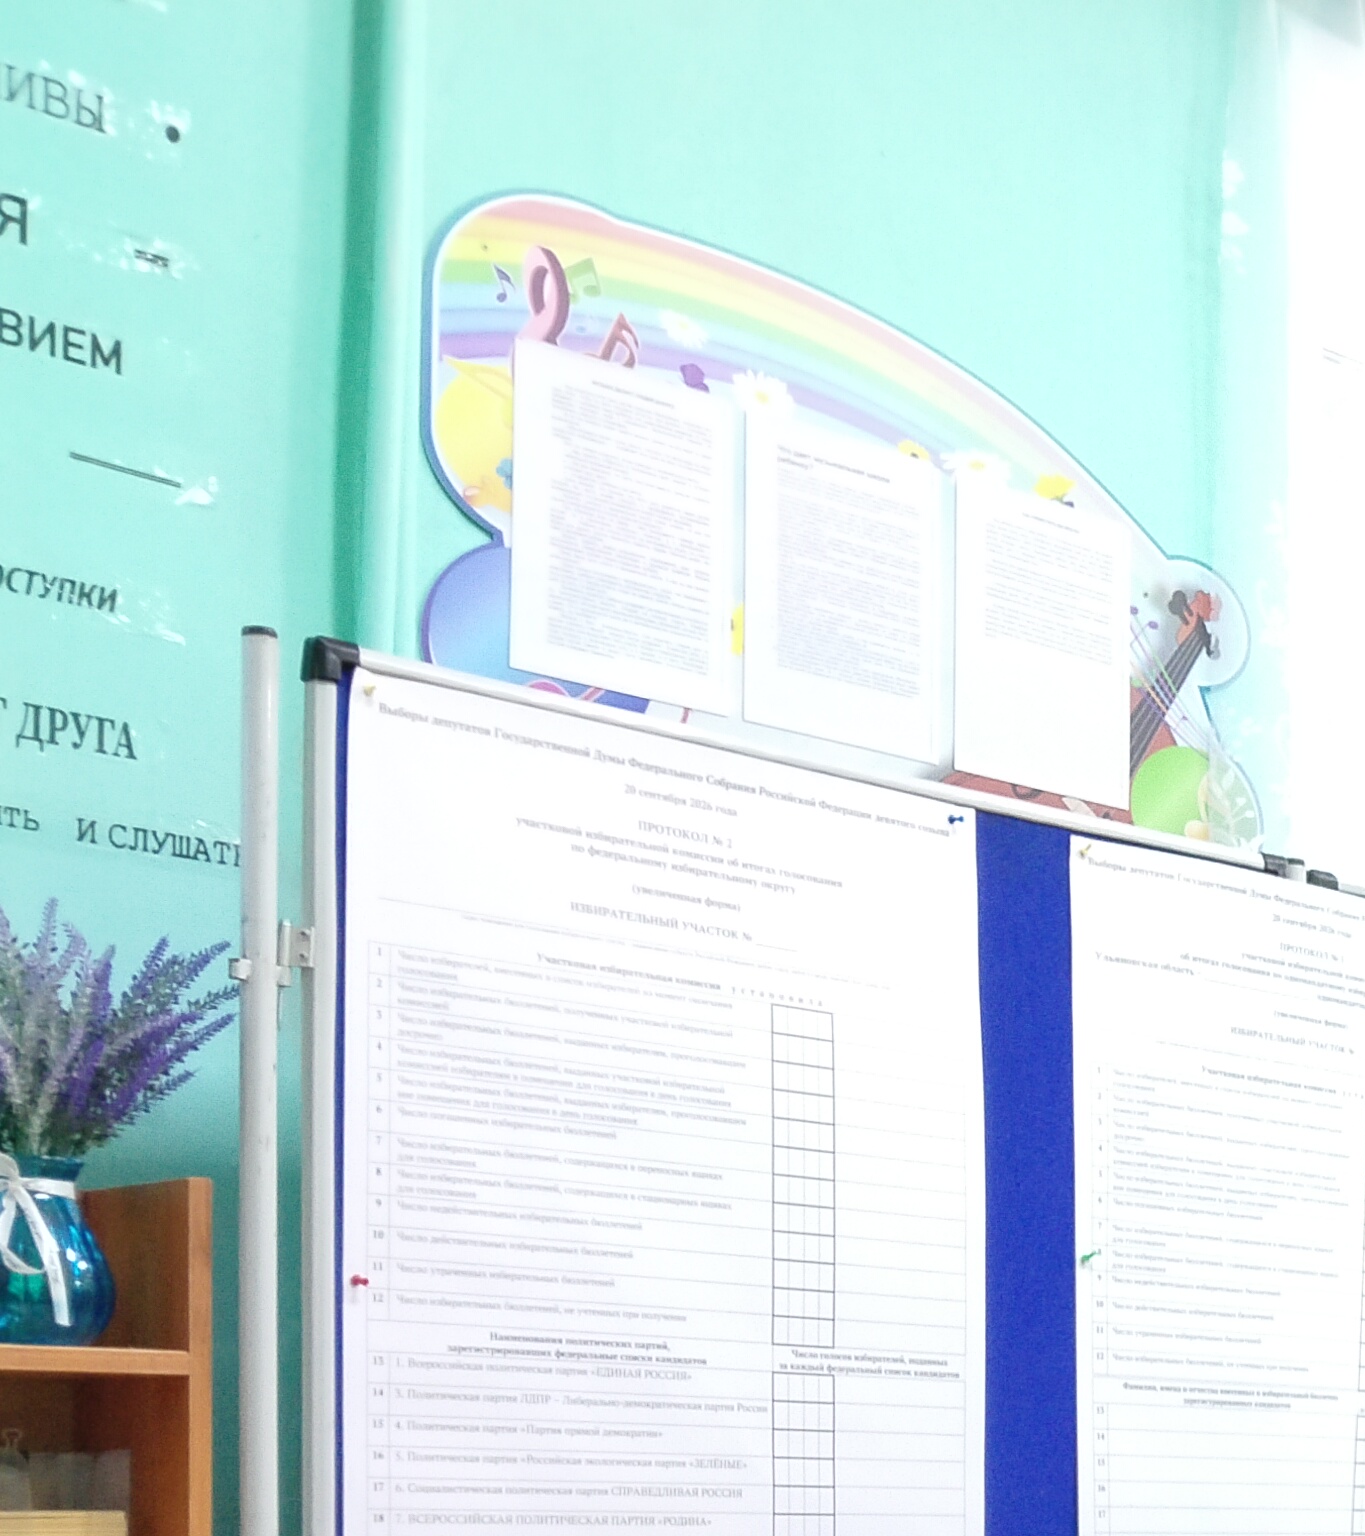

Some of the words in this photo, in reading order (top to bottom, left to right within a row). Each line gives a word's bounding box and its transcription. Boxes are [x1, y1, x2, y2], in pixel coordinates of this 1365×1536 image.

[0, 564, 118, 613] СТУПКИ
[15, 702, 138, 760] ДРУГА
[76, 818, 98, 844] И
[638, 819, 709, 845] ПРОТОКОЛ
